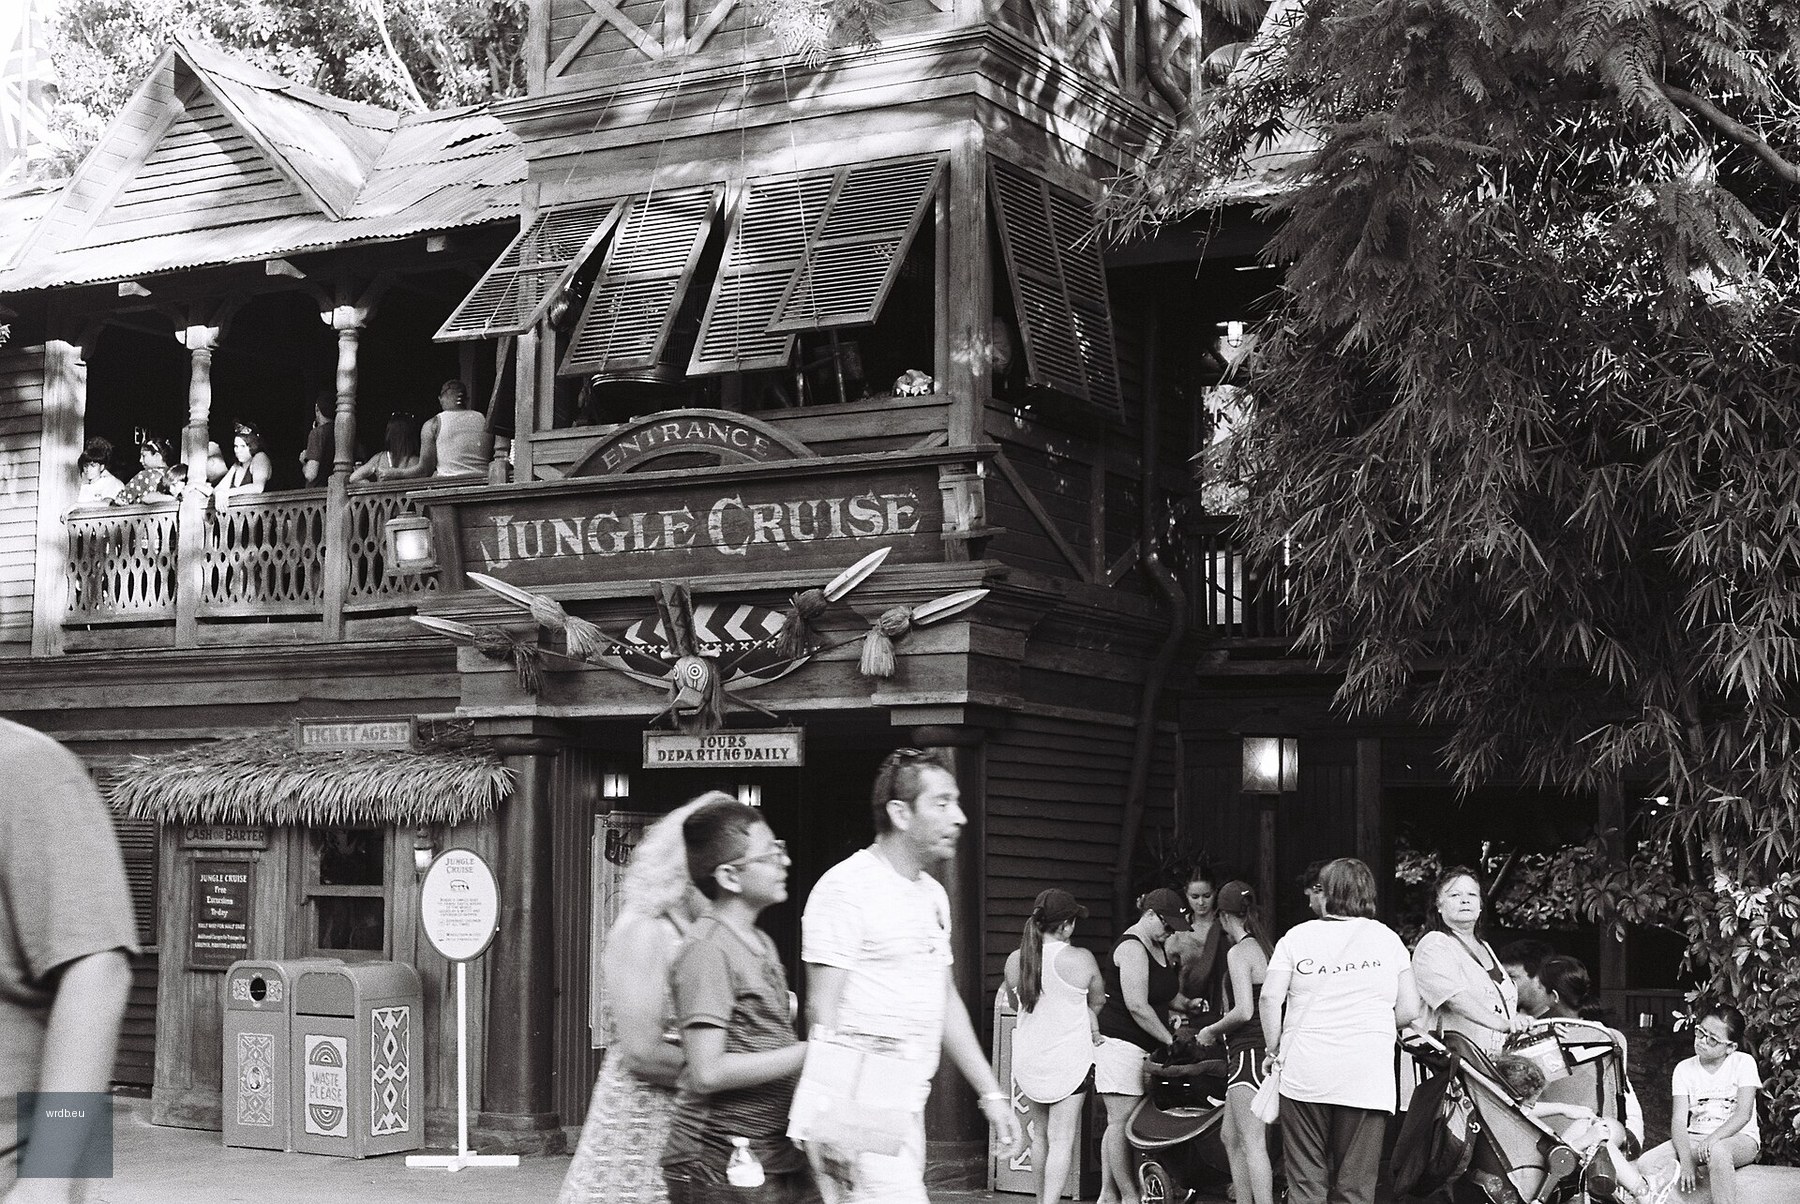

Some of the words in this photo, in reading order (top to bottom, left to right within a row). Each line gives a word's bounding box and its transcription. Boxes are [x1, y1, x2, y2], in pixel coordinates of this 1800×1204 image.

[602, 421, 770, 470] ENTRANCE
[480, 505, 696, 571] JUNGLE
[708, 489, 920, 556] CRUISE
[305, 726, 357, 741] TICKET
[362, 724, 408, 741] AGENT
[700, 736, 747, 748] TOURS
[657, 748, 741, 761] DEPARTING
[744, 747, 790, 760] DAILY
[186, 828, 212, 840] CASH
[225, 828, 265, 841] BARTER
[445, 858, 475, 866] JUNGLE
[446, 866, 474, 874] CRUISE
[200, 874, 223, 882] JUNGLE
[225, 874, 247, 883] CRUISE
[311, 1071, 339, 1087] WASTE
[310, 1085, 343, 1102] PLEASE
